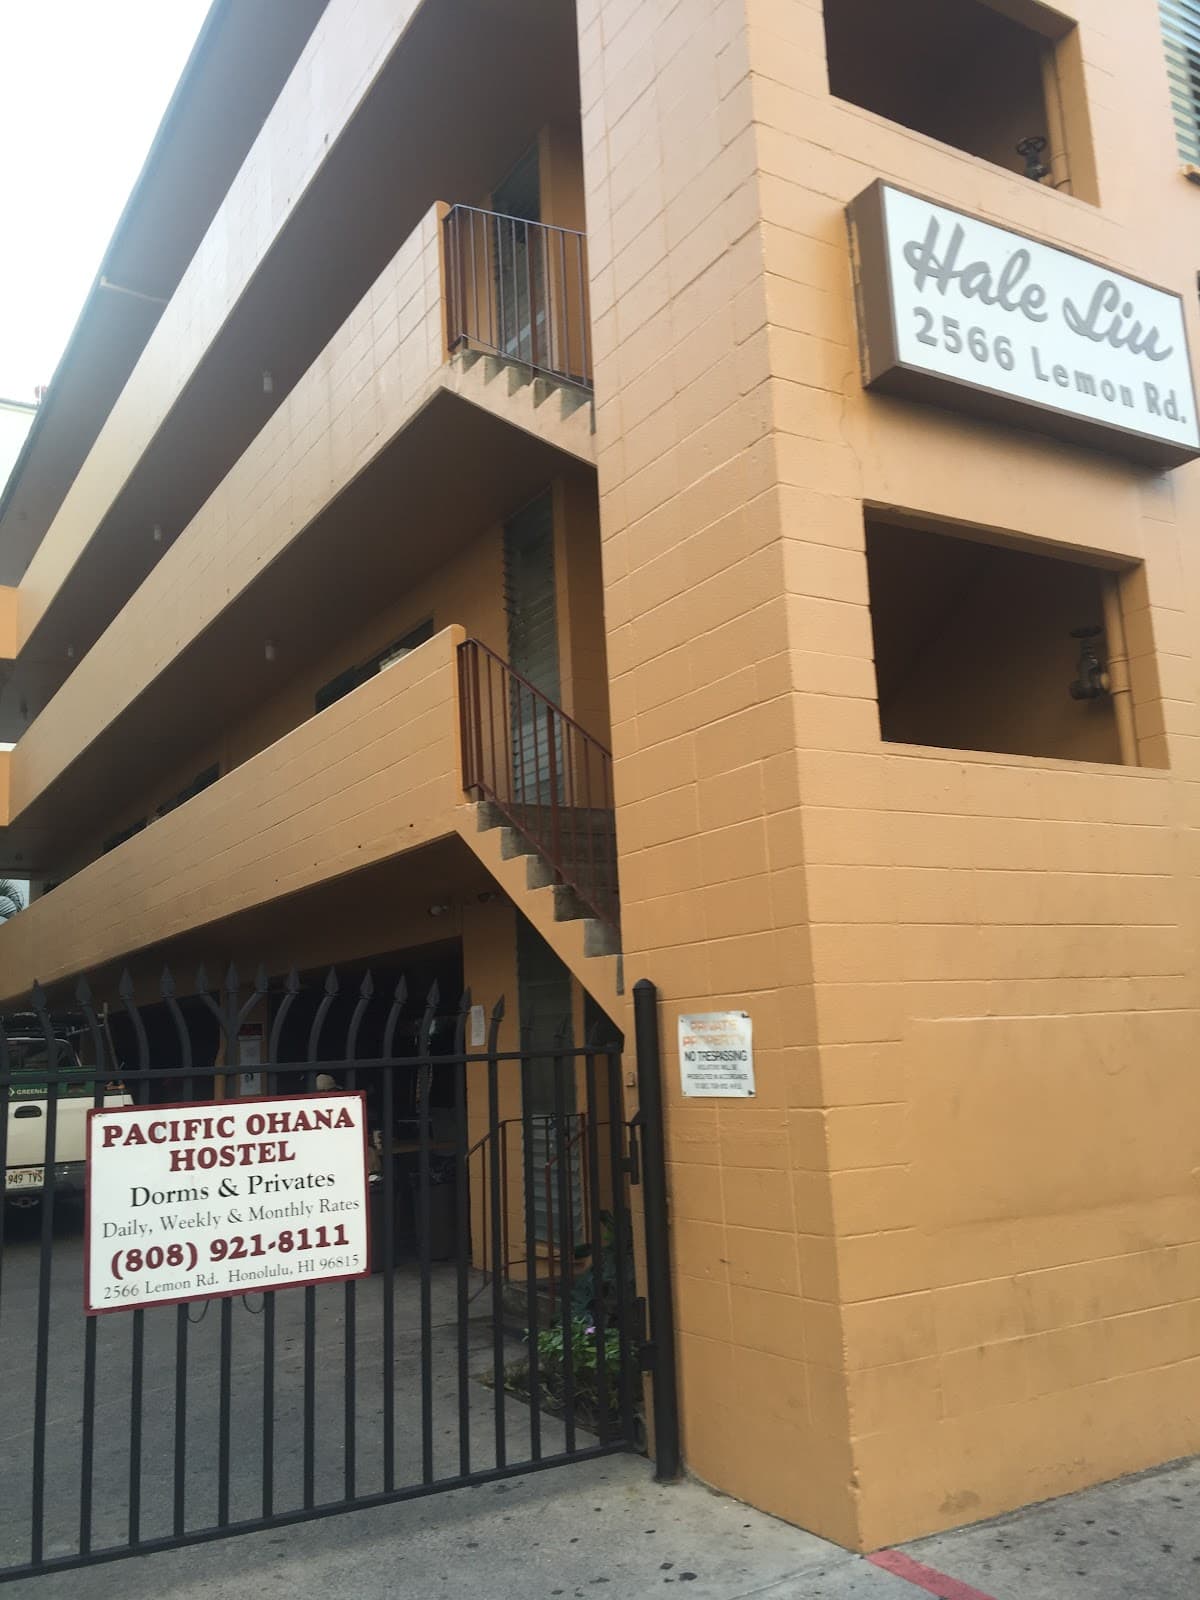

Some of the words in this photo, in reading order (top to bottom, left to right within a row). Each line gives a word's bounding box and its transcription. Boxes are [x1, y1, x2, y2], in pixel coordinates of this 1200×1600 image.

[902, 214, 1048, 322] Hale
[913, 306, 1015, 371] 2566
[1031, 346, 1134, 408] Lemon
[1143, 381, 1186, 424] Rd.
[684, 1050, 696, 1062] NO
[697, 1050, 747, 1062] TRESPASSING
[102, 1115, 236, 1148] PACIFIC
[246, 1107, 355, 1136] OHANA
[169, 1140, 296, 1172] HOSTEL
[8, 1173, 23, 1185] 949
[130, 1185, 209, 1207] Dorms
[218, 1177, 239, 1198] &
[248, 1172, 336, 1195] Privates
[103, 1218, 153, 1239] Daily,
[160, 1211, 222, 1232] Weekly
[227, 1208, 243, 1224] &
[249, 1201, 314, 1221] Monthly
[320, 1198, 360, 1214] Rates
[111, 1242, 198, 1280] (808)
[210, 1224, 349, 1262] 921-8111
[103, 1284, 139, 1300] 2566
[145, 1279, 191, 1294] Lemon
[196, 1273, 219, 1287] Rd.
[228, 1267, 293, 1283] Honolulu,
[298, 1260, 315, 1273] HI
[319, 1254, 360, 1270] 96815
